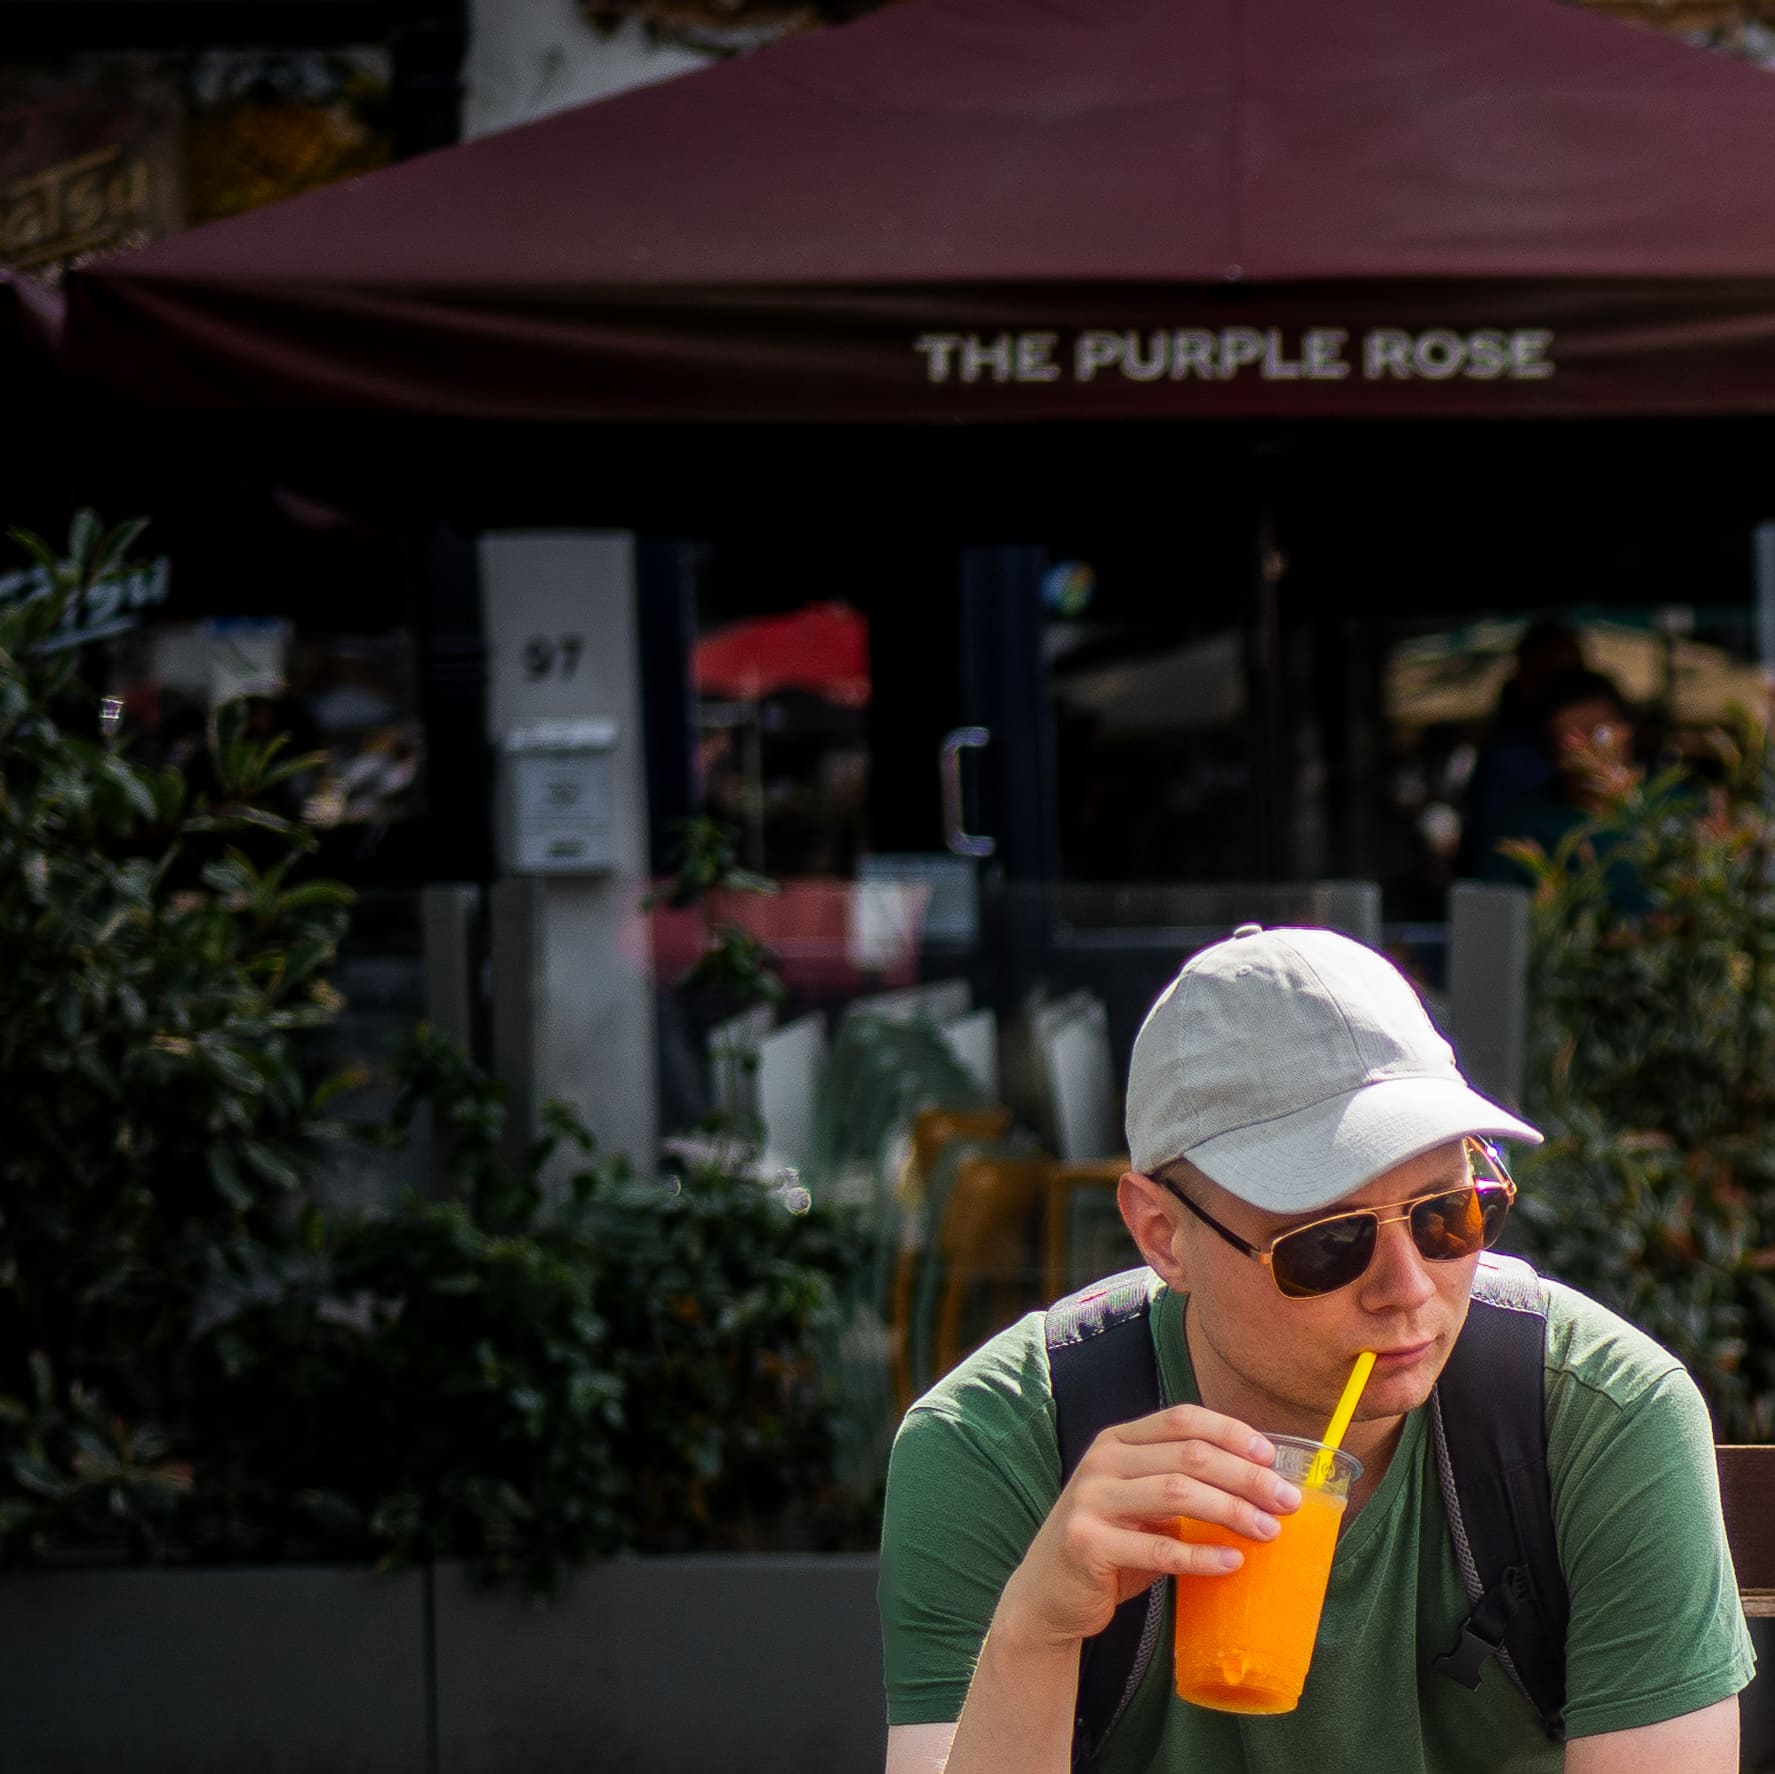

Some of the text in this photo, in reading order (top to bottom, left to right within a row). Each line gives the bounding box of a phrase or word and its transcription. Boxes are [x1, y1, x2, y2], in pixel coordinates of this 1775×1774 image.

[914, 327, 1556, 383] THE PURPLE ROSE
[524, 633, 585, 682] 97
